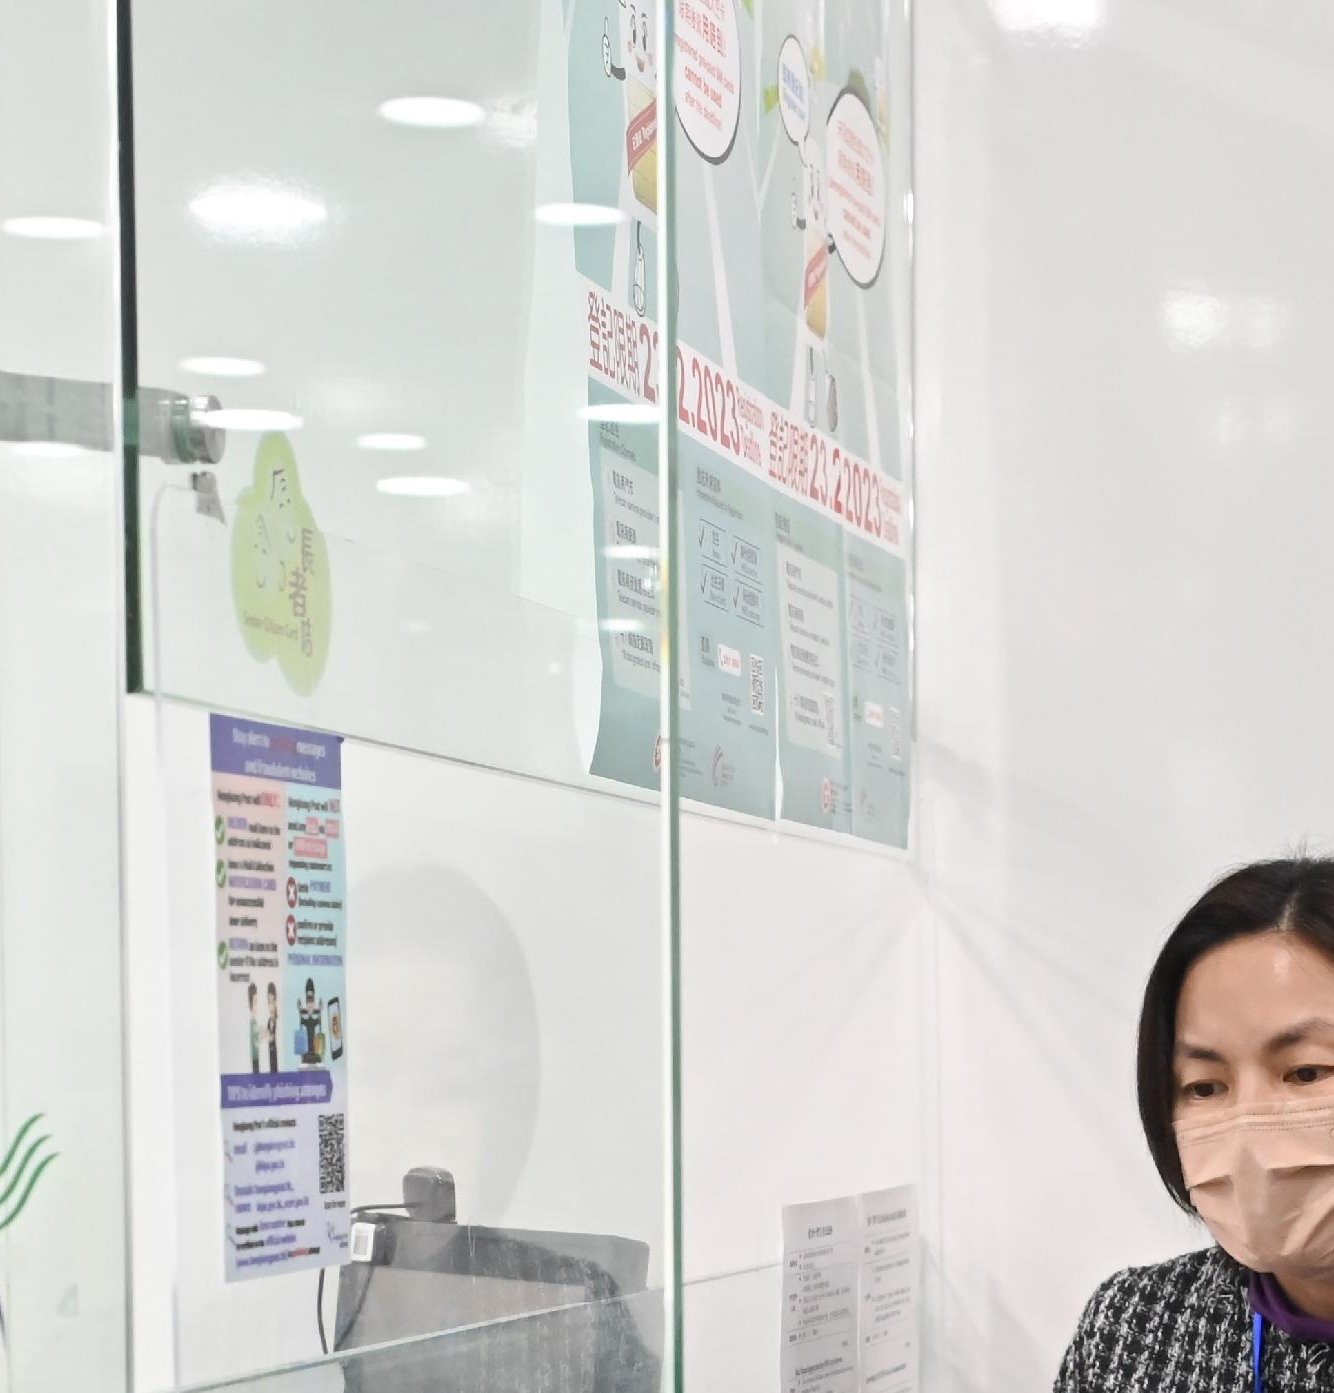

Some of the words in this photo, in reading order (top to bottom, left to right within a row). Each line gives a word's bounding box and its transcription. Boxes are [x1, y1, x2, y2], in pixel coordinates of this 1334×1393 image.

[587, 290, 640, 398] 登記限期
[810, 433, 882, 538] 23.2.2023
